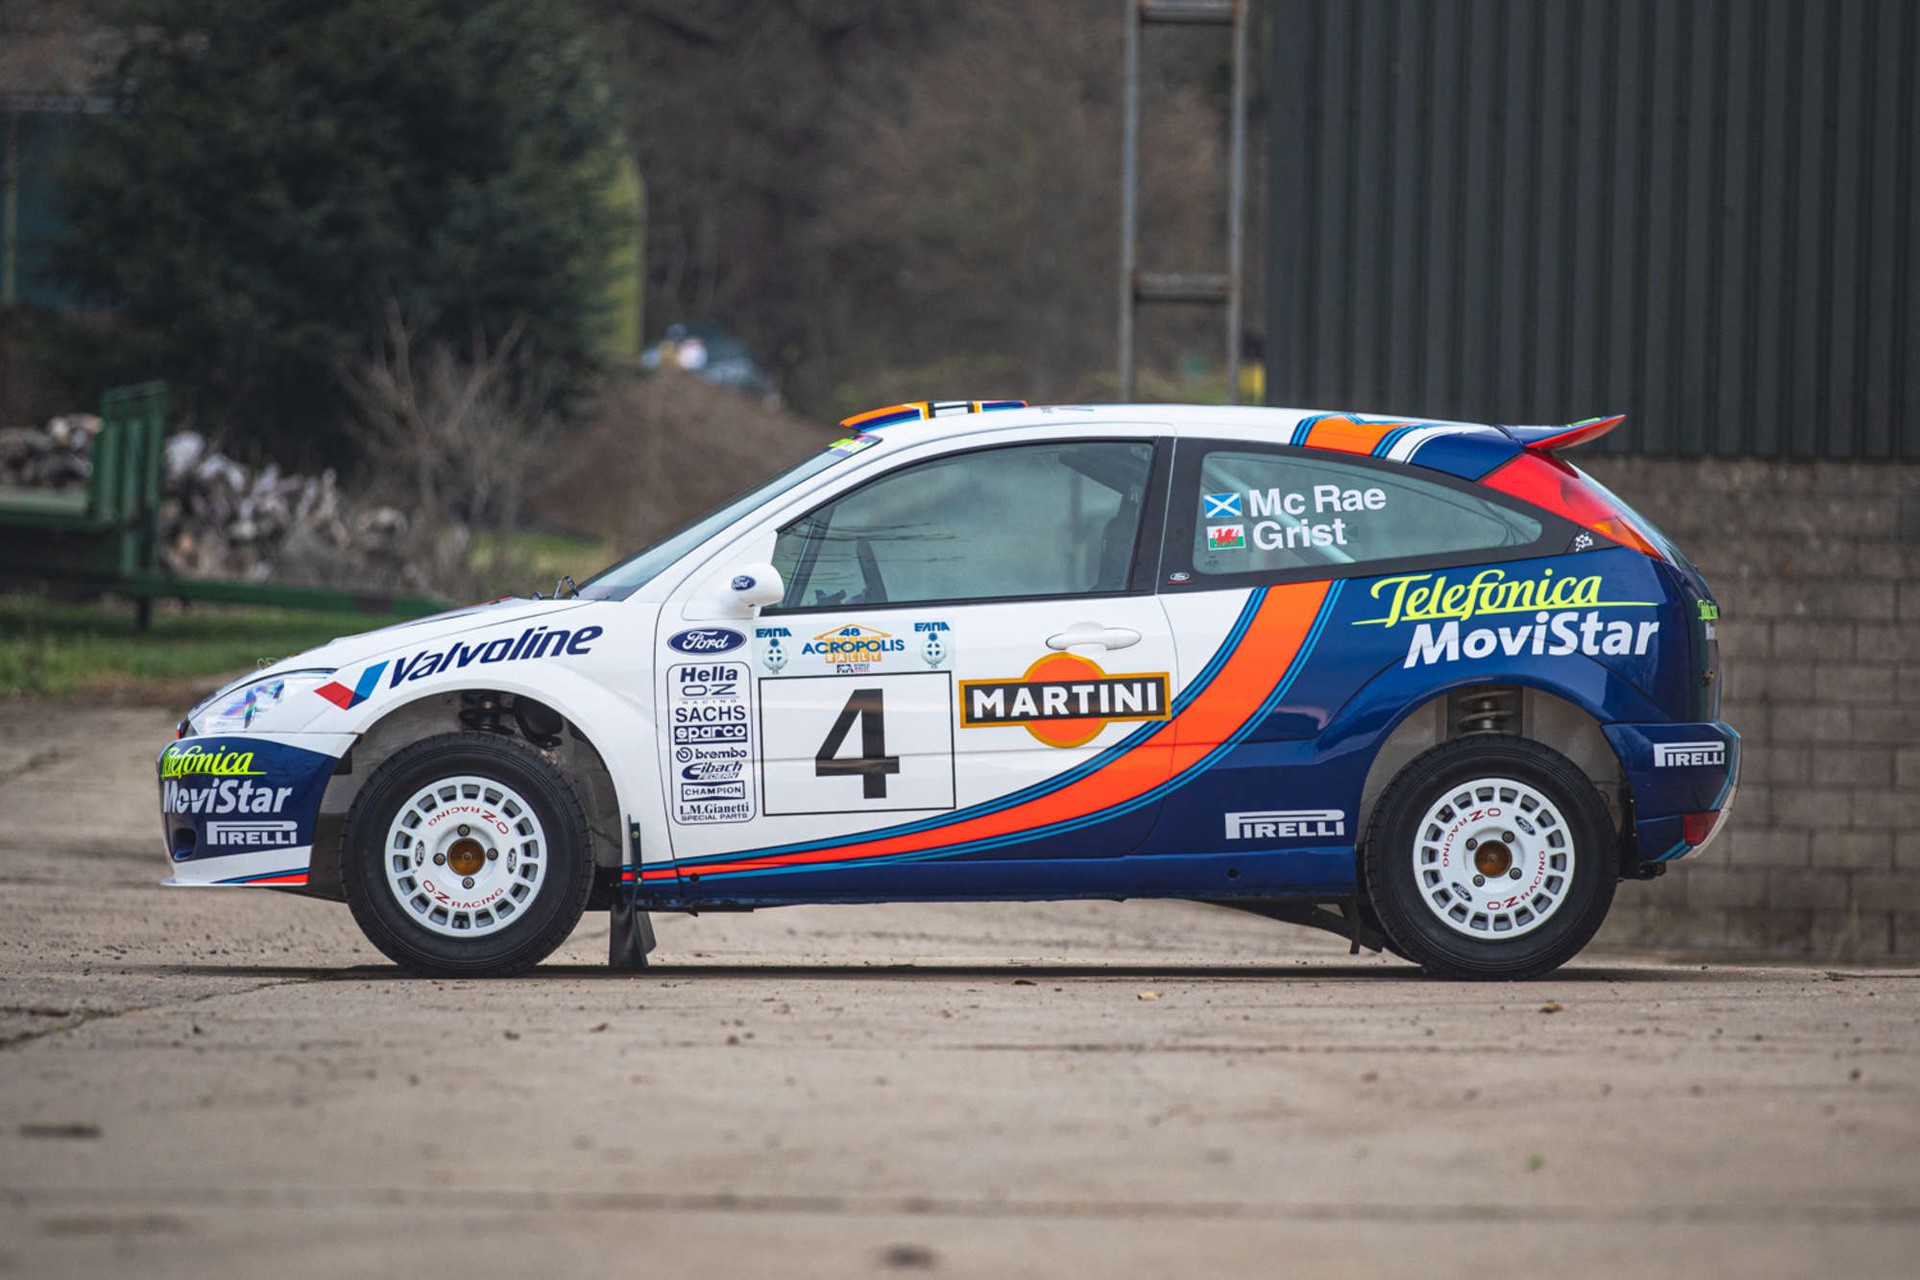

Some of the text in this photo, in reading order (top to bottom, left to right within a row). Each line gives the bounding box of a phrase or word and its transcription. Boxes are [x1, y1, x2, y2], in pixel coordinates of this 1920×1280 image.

[1249, 485, 1387, 517] Mc Rae
[1252, 518, 1348, 551] Grist
[682, 630, 729, 650] Ford
[839, 628, 861, 637] 48
[1403, 611, 1660, 669] MoviStar
[389, 626, 604, 690] Valvoline
[801, 639, 905, 655] ACROPOLIS
[826, 652, 881, 664] RALLY
[680, 666, 738, 682] Hella
[972, 682, 1159, 719] MARTINI
[675, 705, 746, 723] SACHS
[675, 725, 746, 743] sparco
[815, 688, 900, 799] 4
[695, 747, 747, 759] brembo
[1653, 741, 1725, 767] PIRELLI
[682, 761, 742, 780] Eibach
[163, 778, 293, 814] MoviStar
[685, 786, 741, 796] CHAMPION
[428, 806, 480, 827] RACING
[1225, 809, 1345, 839] PIRELLI
[207, 821, 298, 845] PIRELLI
[1442, 818, 1468, 867] RACING
[1521, 850, 1546, 900] RACING
[451, 887, 504, 909] RACING
